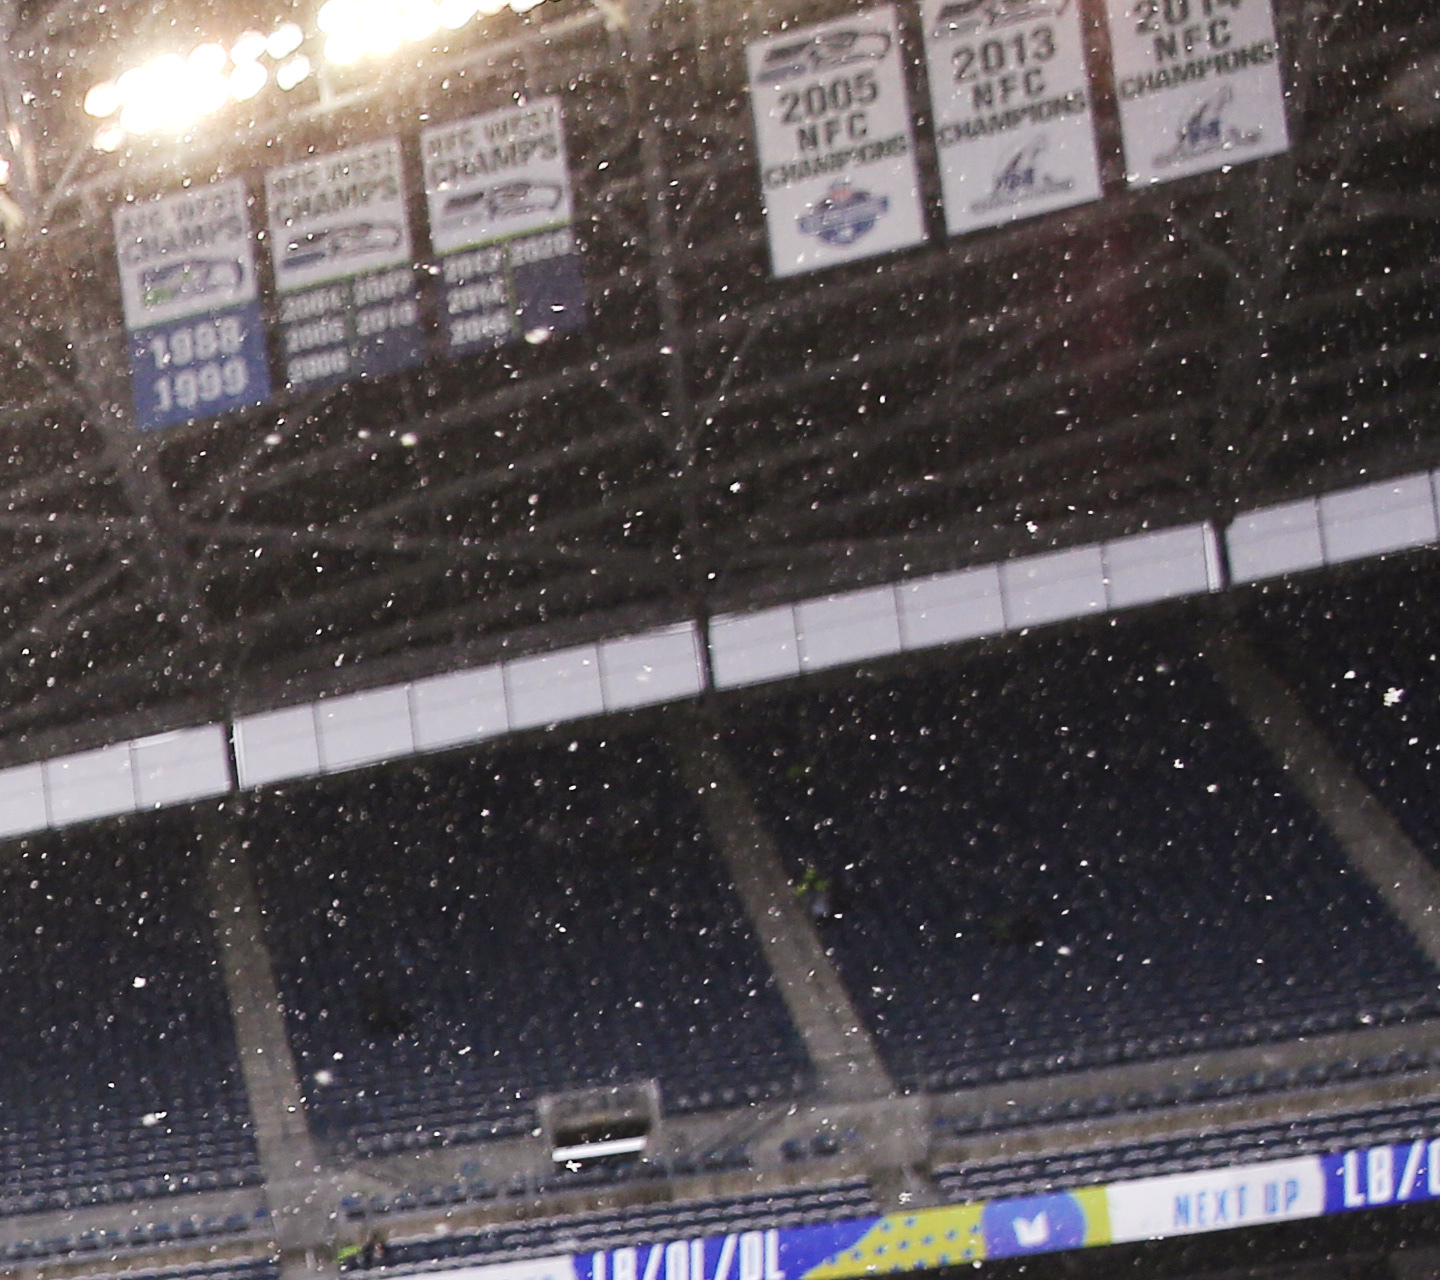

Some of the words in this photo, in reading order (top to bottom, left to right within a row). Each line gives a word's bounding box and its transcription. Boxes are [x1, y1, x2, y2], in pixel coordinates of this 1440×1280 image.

[951, 26, 1056, 85] 2013
[1118, 39, 1275, 99] CHAMPIONS
[1153, 18, 1230, 63] NFC
[779, 68, 879, 126] 2005
[971, 67, 1046, 111] NFC
[796, 111, 868, 153] NFC
[936, 90, 1086, 147] CHAMPIONS
[762, 132, 909, 191] CHAMPIONS
[1174, 1189, 1249, 1229] NEXT
[1260, 1178, 1301, 1217] UP
